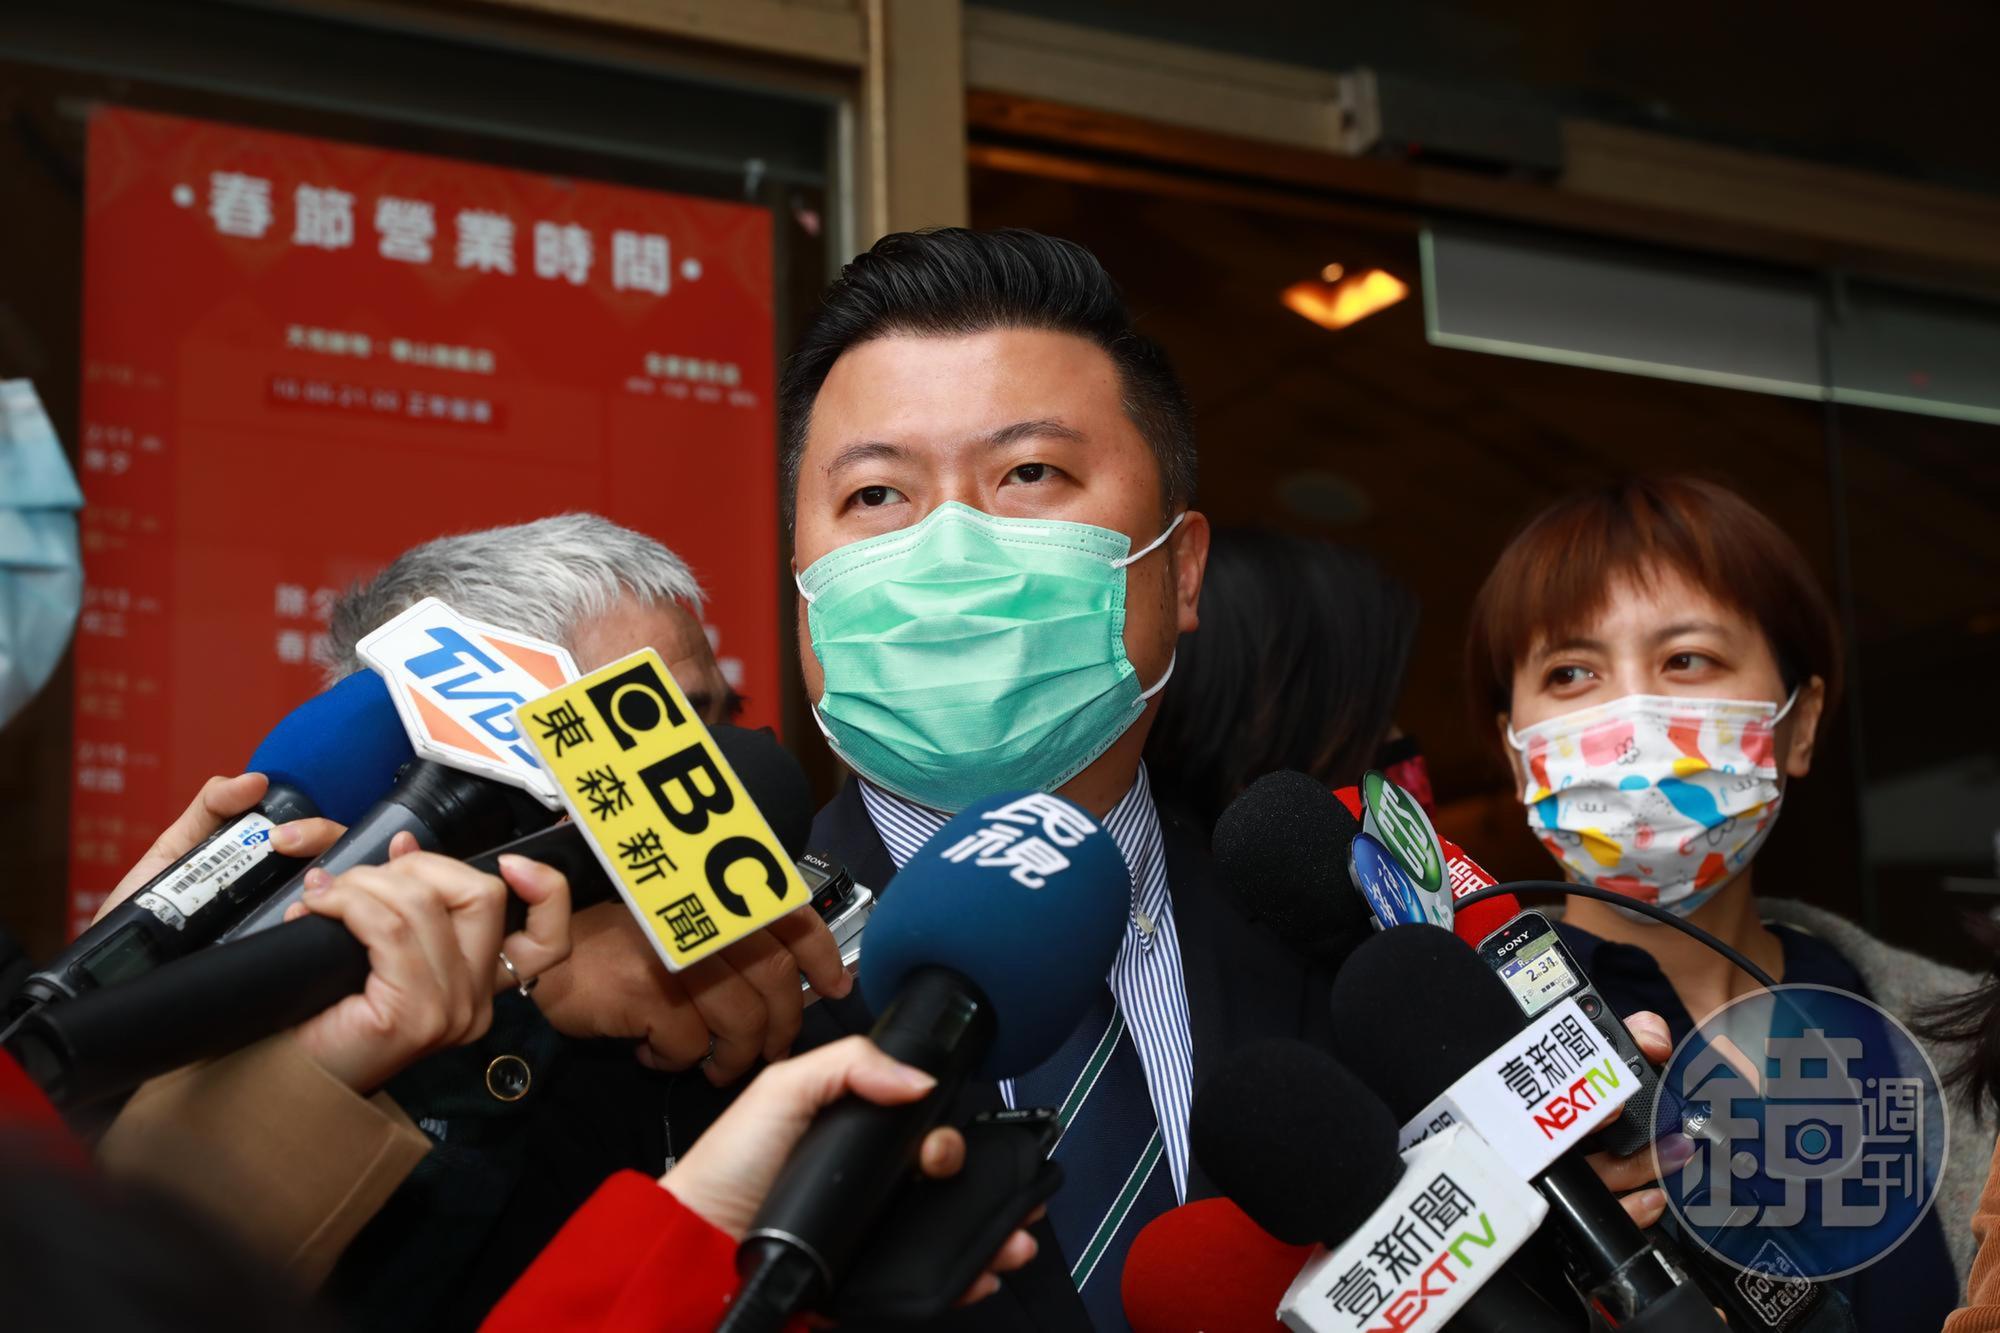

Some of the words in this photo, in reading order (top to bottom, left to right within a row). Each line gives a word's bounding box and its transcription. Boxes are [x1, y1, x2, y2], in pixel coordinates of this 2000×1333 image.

[209, 170, 671, 296] 春節營業時間
[404, 627, 541, 769] TVB
[532, 700, 720, 953] 東森新聞
[803, 854, 830, 870] SONY
[940, 792, 1098, 889] 民視
[1497, 930, 1529, 957] SONY
[1498, 1014, 1600, 1110] 壹新聞
[1325, 1172, 1476, 1328] 壹新聞
